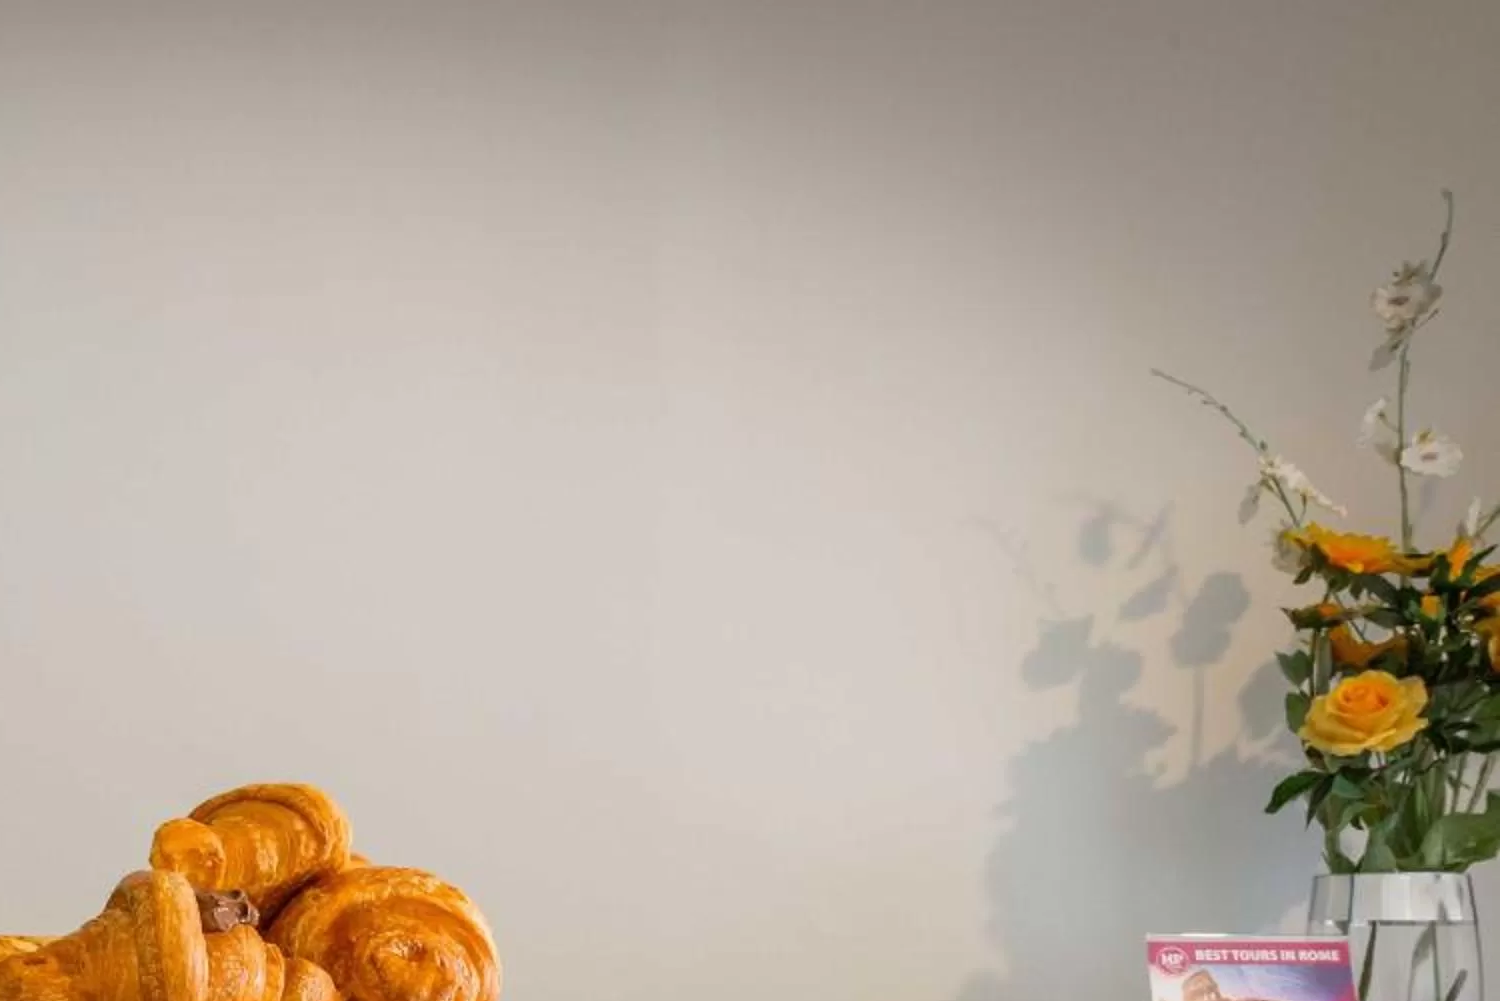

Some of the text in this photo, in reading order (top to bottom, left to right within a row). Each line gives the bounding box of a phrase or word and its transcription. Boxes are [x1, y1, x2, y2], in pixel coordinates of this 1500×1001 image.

[1195, 949, 1340, 961] BEST TOURS IN ROME
